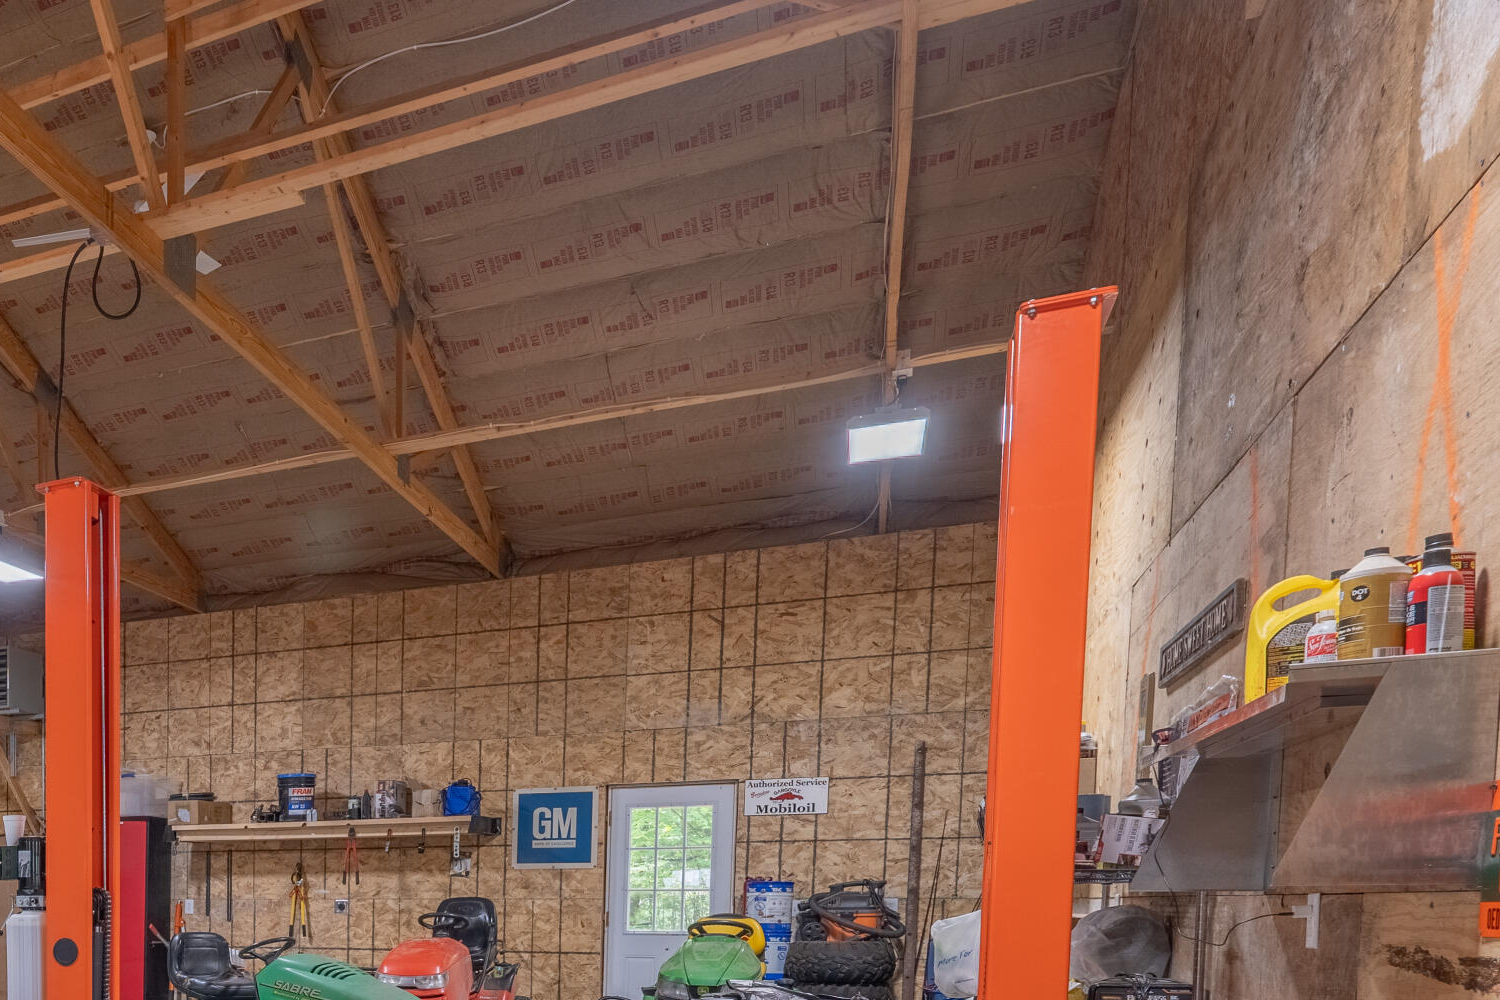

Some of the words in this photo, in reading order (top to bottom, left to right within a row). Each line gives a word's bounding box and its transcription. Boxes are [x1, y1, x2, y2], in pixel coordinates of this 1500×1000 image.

[1351, 588, 1369, 597] DOT
[1206, 600, 1227, 641] HOME
[747, 780, 793, 788] Authorized
[796, 778, 827, 786] Service
[756, 803, 816, 814] Mobiloil
[532, 807, 577, 839] GM
[274, 980, 322, 999] SABRE
